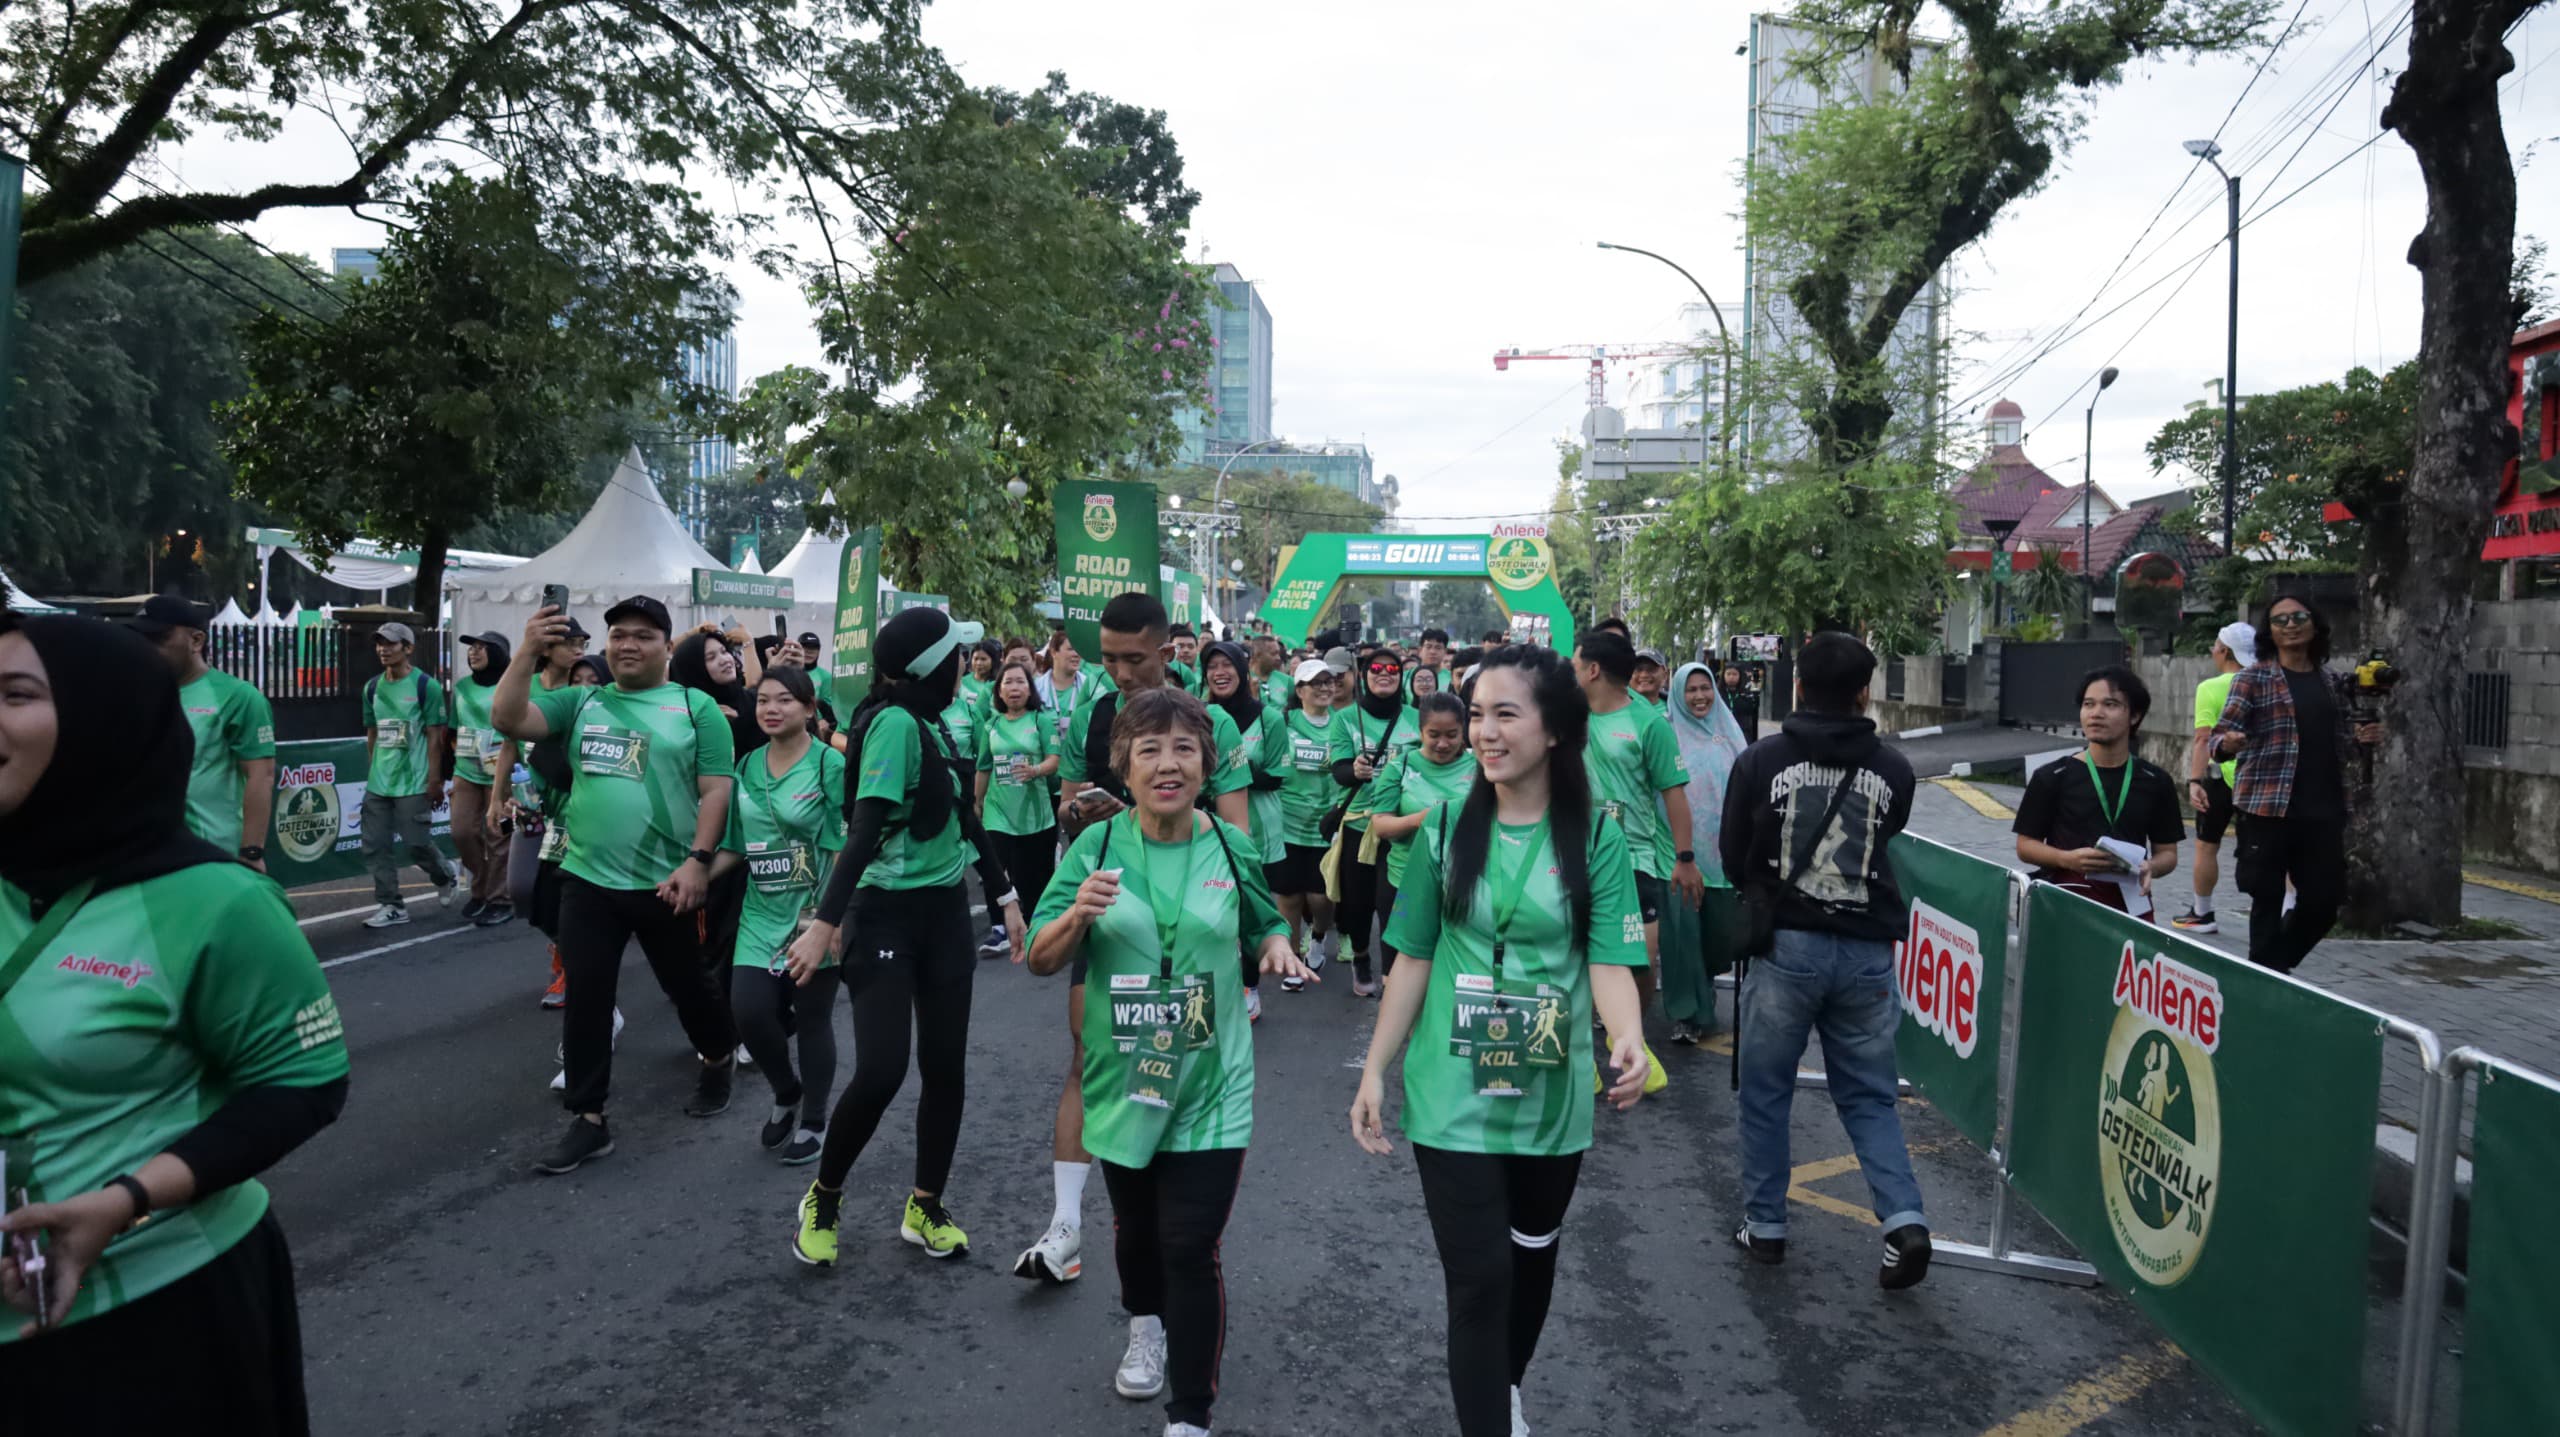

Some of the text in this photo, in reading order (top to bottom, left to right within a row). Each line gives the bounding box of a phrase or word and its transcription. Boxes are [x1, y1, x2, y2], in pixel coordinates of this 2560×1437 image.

[1492, 524, 1545, 537] Anlene
[1384, 543, 1444, 563] GO!!!
[1075, 554, 1131, 577] ROAD
[1488, 560, 1548, 569] OSTEOWALK
[713, 580, 749, 594] COMMAND
[750, 583, 776, 597] CENTER
[1064, 576, 1147, 599] CAPTAIN
[1277, 589, 1317, 600] TANPA
[1288, 579, 1325, 591] AKTIF
[1271, 599, 1310, 610] BATAS
[840, 606, 863, 628] ROAD
[1068, 607, 1103, 622] FOLL
[833, 628, 868, 653] CAPTAIN
[581, 741, 624, 759] W2299
[280, 767, 333, 787] Anlene
[278, 816, 337, 833] OSTEOWALK
[336, 840, 362, 852] BERSA
[750, 858, 791, 875] W2300
[58, 955, 131, 979] Anlene
[1893, 910, 1975, 1043] lene
[2116, 947, 2216, 1046] Anlene
[1479, 1050, 1519, 1067] KOL
[1137, 1058, 1173, 1079] KOL
[2149, 1122, 2185, 1156] LANGKAH
[2101, 1107, 2212, 1210] OSTEOWALK
